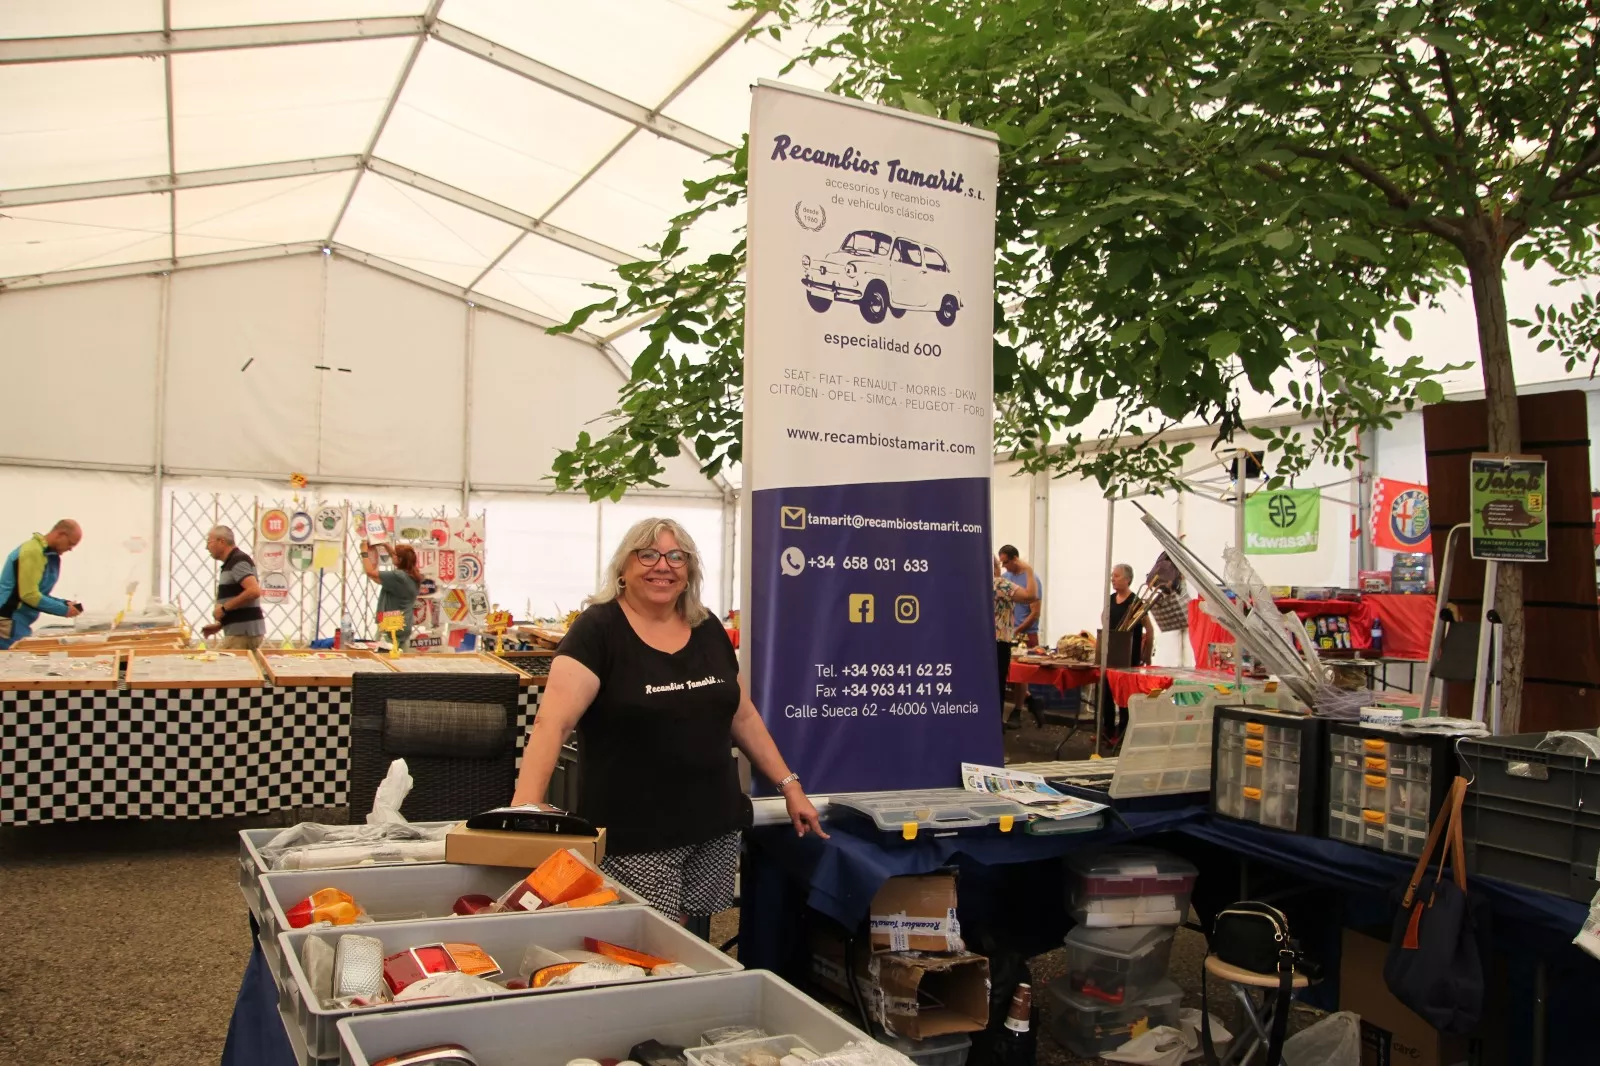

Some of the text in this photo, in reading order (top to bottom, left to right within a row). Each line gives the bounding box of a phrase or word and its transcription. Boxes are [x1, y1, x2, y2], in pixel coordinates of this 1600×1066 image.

[770, 134, 880, 176] Recambios
[886, 159, 965, 194] Tamarit
[825, 177, 941, 208] accesorios y recambios
[802, 206, 819, 216] desde
[831, 194, 935, 222] de vehículos clásicos
[824, 333, 942, 358] especialidad 600
[784, 368, 811, 382] SEAT
[819, 373, 843, 385] FIAT
[853, 376, 898, 392] RENAULT
[906, 383, 946, 397] MORRIS
[955, 388, 977, 401] DKW
[828, 390, 857, 402] OPEL
[866, 393, 897, 407] SIMCA
[905, 398, 955, 413] PEUGEOT
[963, 404, 985, 417] FORD
[786, 427, 976, 455] www.recambiostamarit.com
[807, 512, 983, 534] tamarit@recambiostamarit.com
[1246, 531, 1319, 549] Kawasaki
[807, 556, 929, 572] +34 658 031 633
[815, 663, 952, 677] Tel. +34 963 41 62 25
[645, 682, 685, 695] Recambios
[686, 675, 716, 690] Tamarit
[815, 683, 952, 698] Fax +34 963 41 41 94
[784, 704, 818, 718] Calle
[821, 702, 858, 717] Sueca
[862, 702, 878, 716] 62
[889, 701, 928, 715] 46006
[931, 701, 979, 715] Valencia
